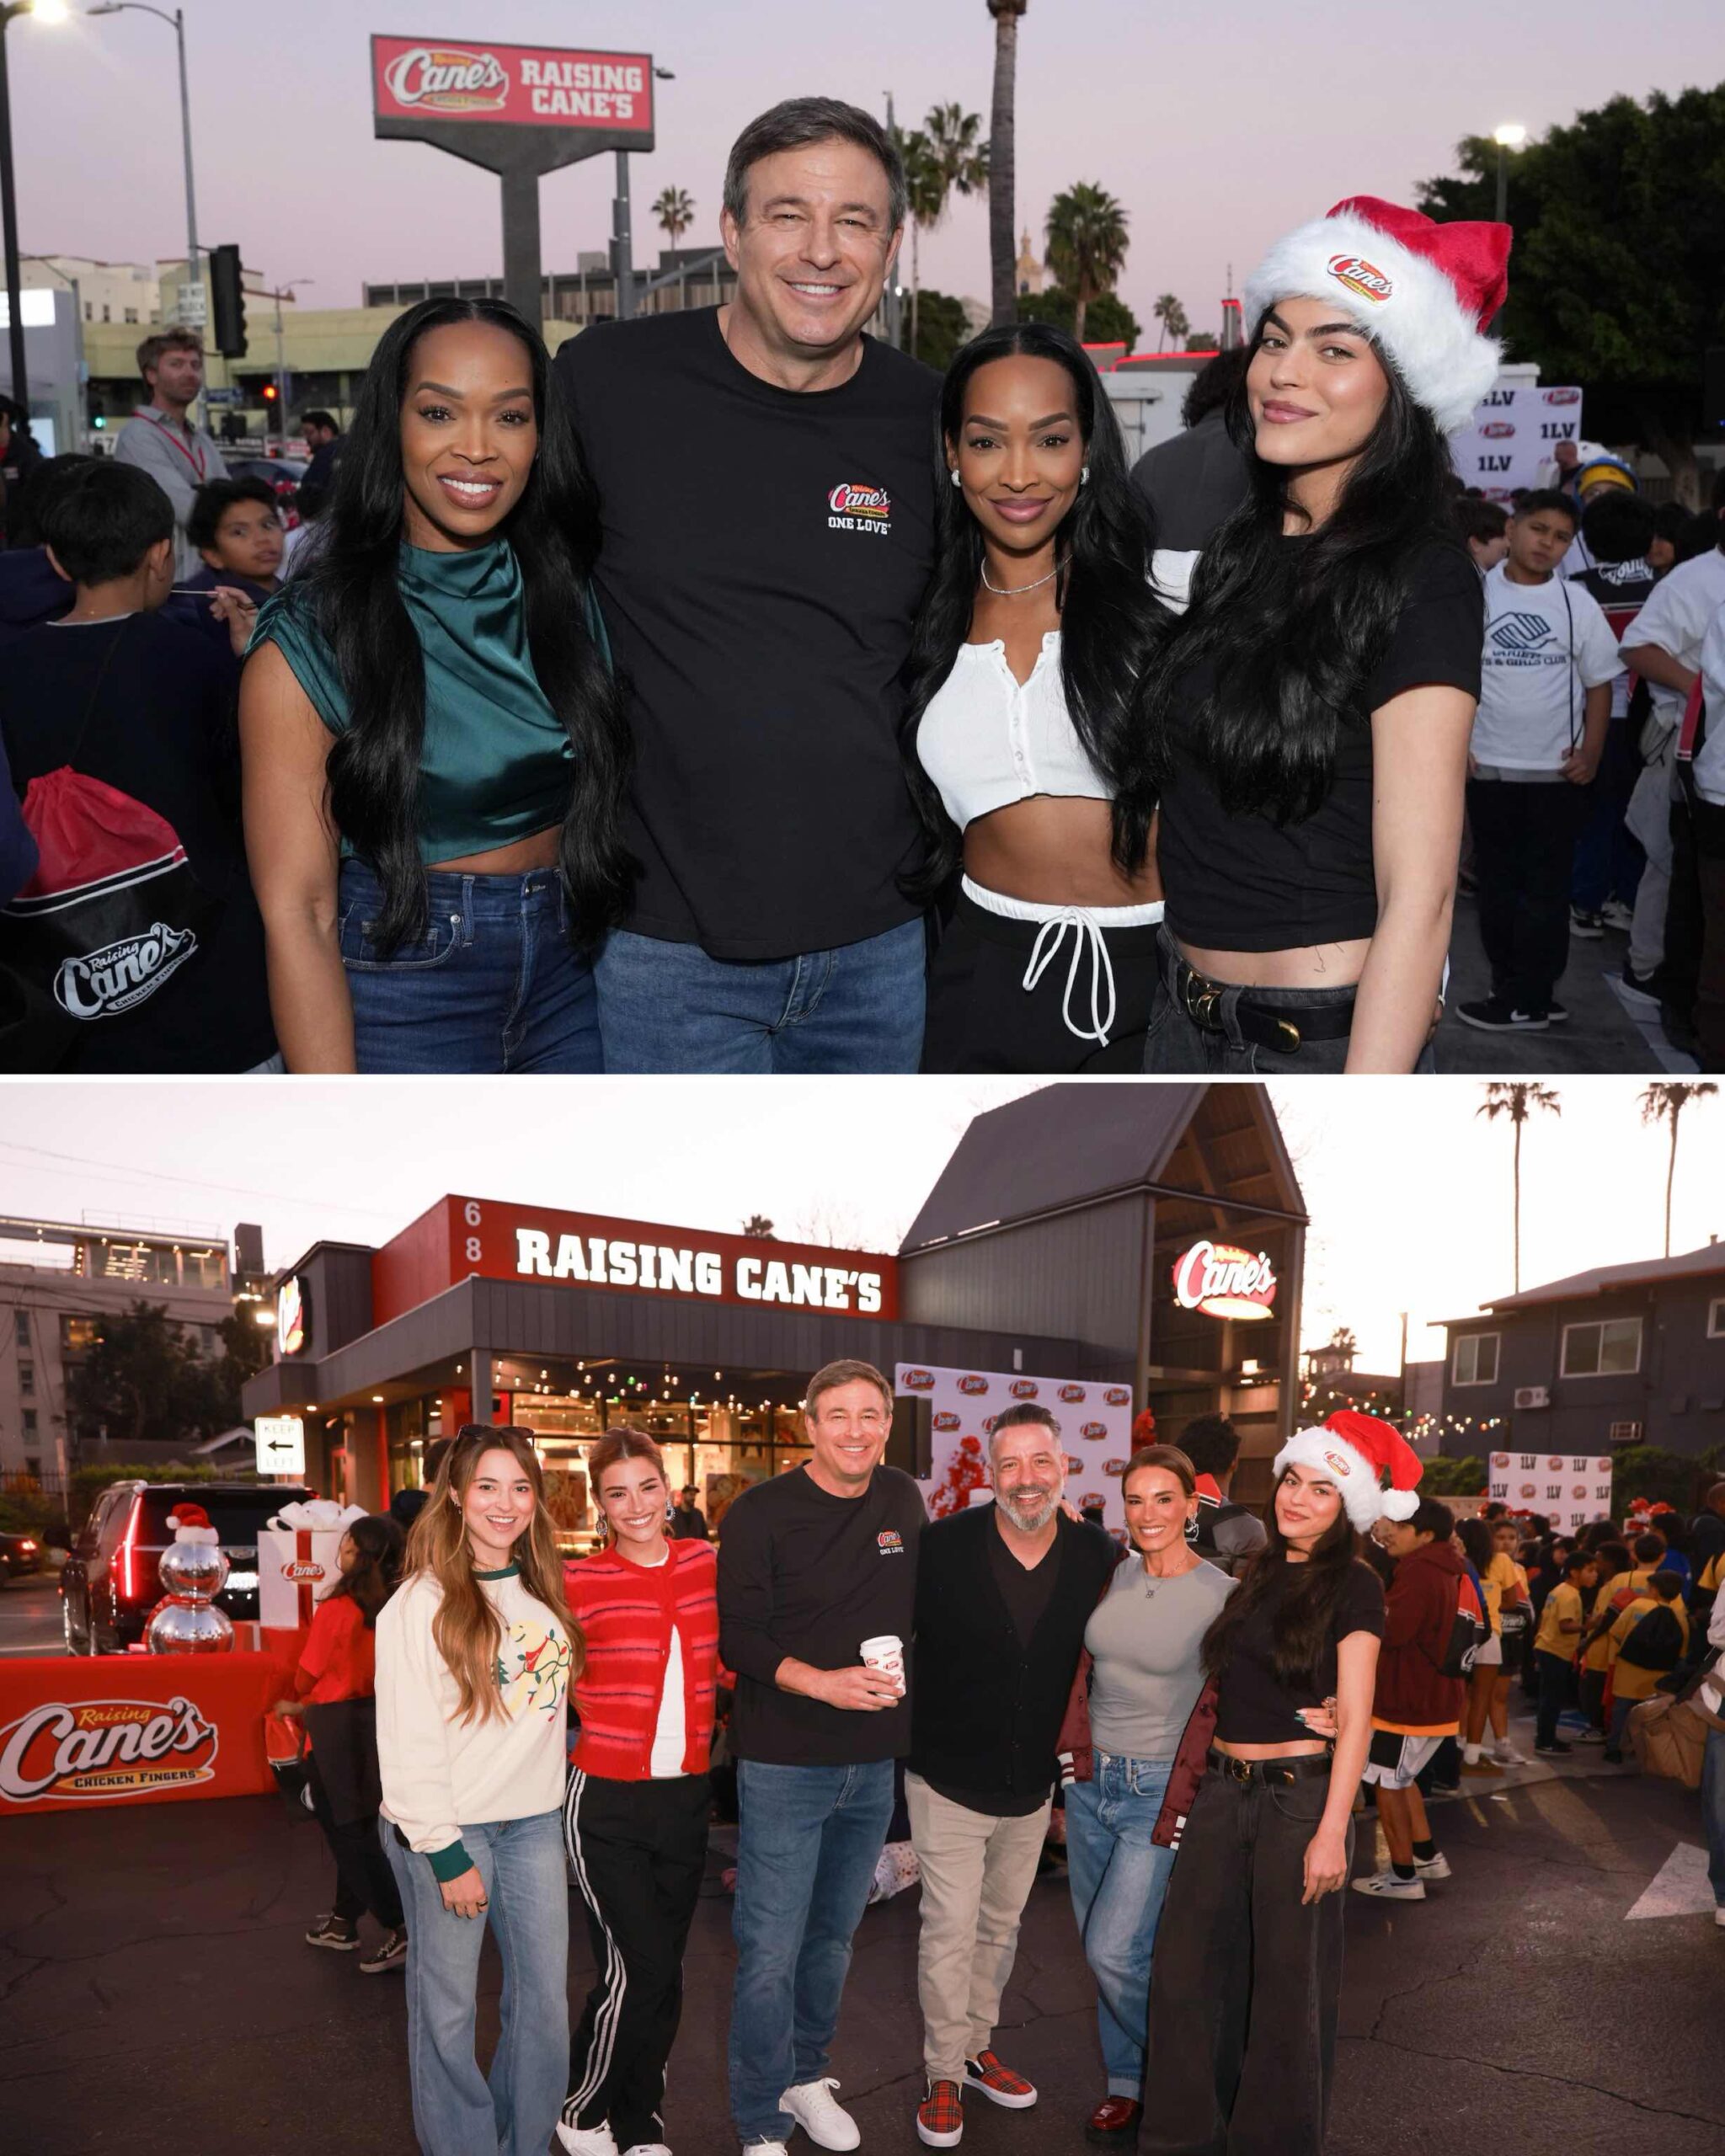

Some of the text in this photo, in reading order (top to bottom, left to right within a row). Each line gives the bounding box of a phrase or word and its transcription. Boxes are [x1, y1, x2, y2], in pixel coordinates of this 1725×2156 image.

[393, 48, 505, 102] Cane's
[521, 59, 643, 93] RAISING
[531, 88, 633, 118] CANE'S
[1327, 254, 1393, 295] Cane's
[1541, 423, 1575, 439] 1LV
[1477, 456, 1512, 472] 1LV
[830, 483, 891, 512] Cane's
[828, 516, 888, 535] ONE LOVE
[88, 942, 141, 972] Raising
[64, 924, 189, 1017] Cane's
[115, 982, 153, 1008] CHICKEN
[515, 1228, 882, 1313] RAISING CANE'S
[1177, 1240, 1277, 1309] Cane's
[264, 1423, 295, 1433] KEEP
[265, 1458, 293, 1468] LEFT
[1520, 1455, 1536, 1470] 1LV
[1573, 1458, 1588, 1472] 1LV
[1492, 1484, 1509, 1497] 1LV
[1546, 1485, 1562, 1499] 1LV
[1596, 1486, 1610, 1499] 1LV
[1570, 1513, 1585, 1527] 1LV
[78, 1707, 152, 1726] Raising
[0, 1700, 215, 1795] Cane's
[74, 1769, 196, 1789] CHICKEN FINGERS
